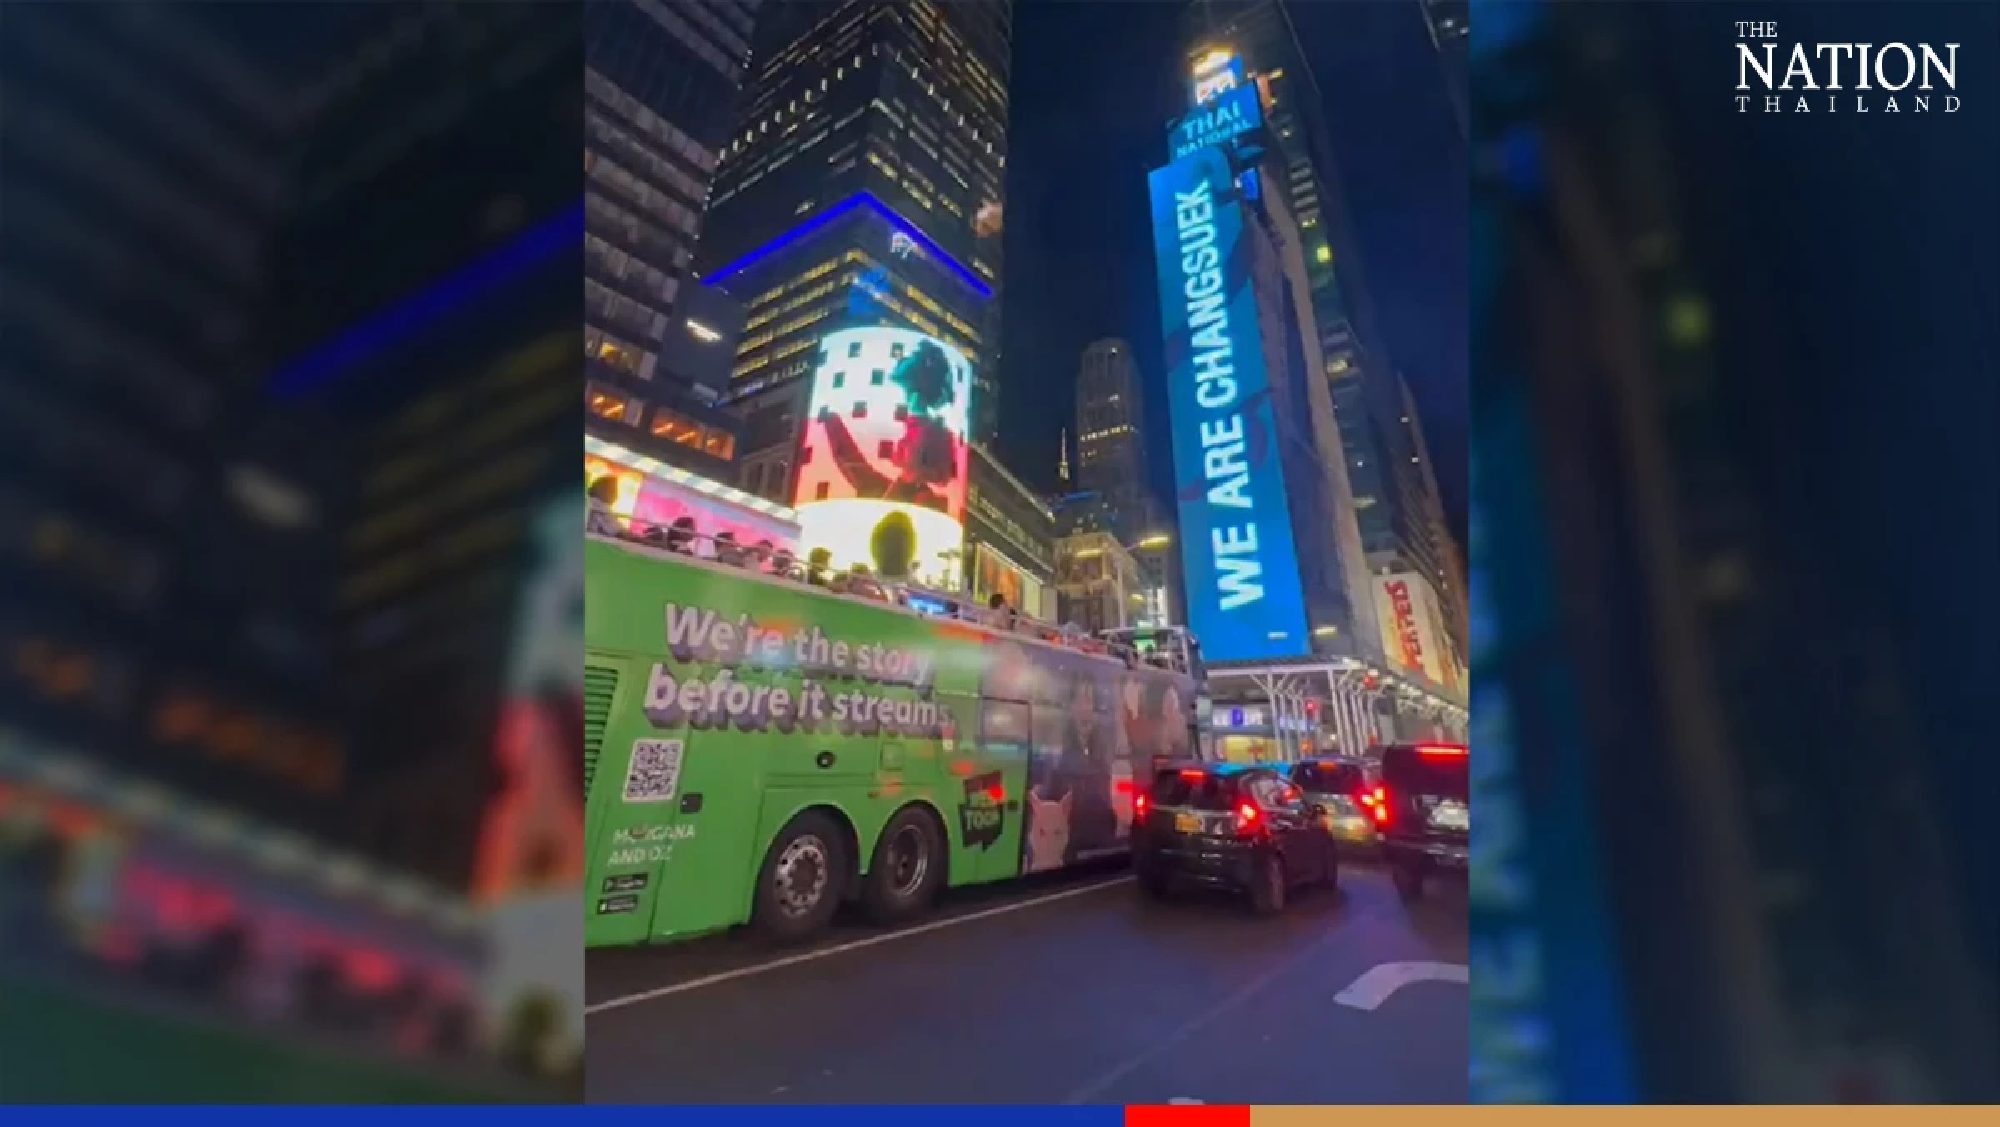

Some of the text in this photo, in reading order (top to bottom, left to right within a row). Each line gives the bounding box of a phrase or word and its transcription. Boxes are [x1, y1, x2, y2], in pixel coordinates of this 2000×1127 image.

[1183, 99, 1242, 140] THAI
[1174, 179, 1265, 611] WE ARE CHANGSUEK
[664, 603, 934, 687] We're the story
[643, 663, 790, 718] before
[798, 678, 824, 720] it
[607, 848, 646, 866] AND
[613, 824, 696, 845] MGANA
